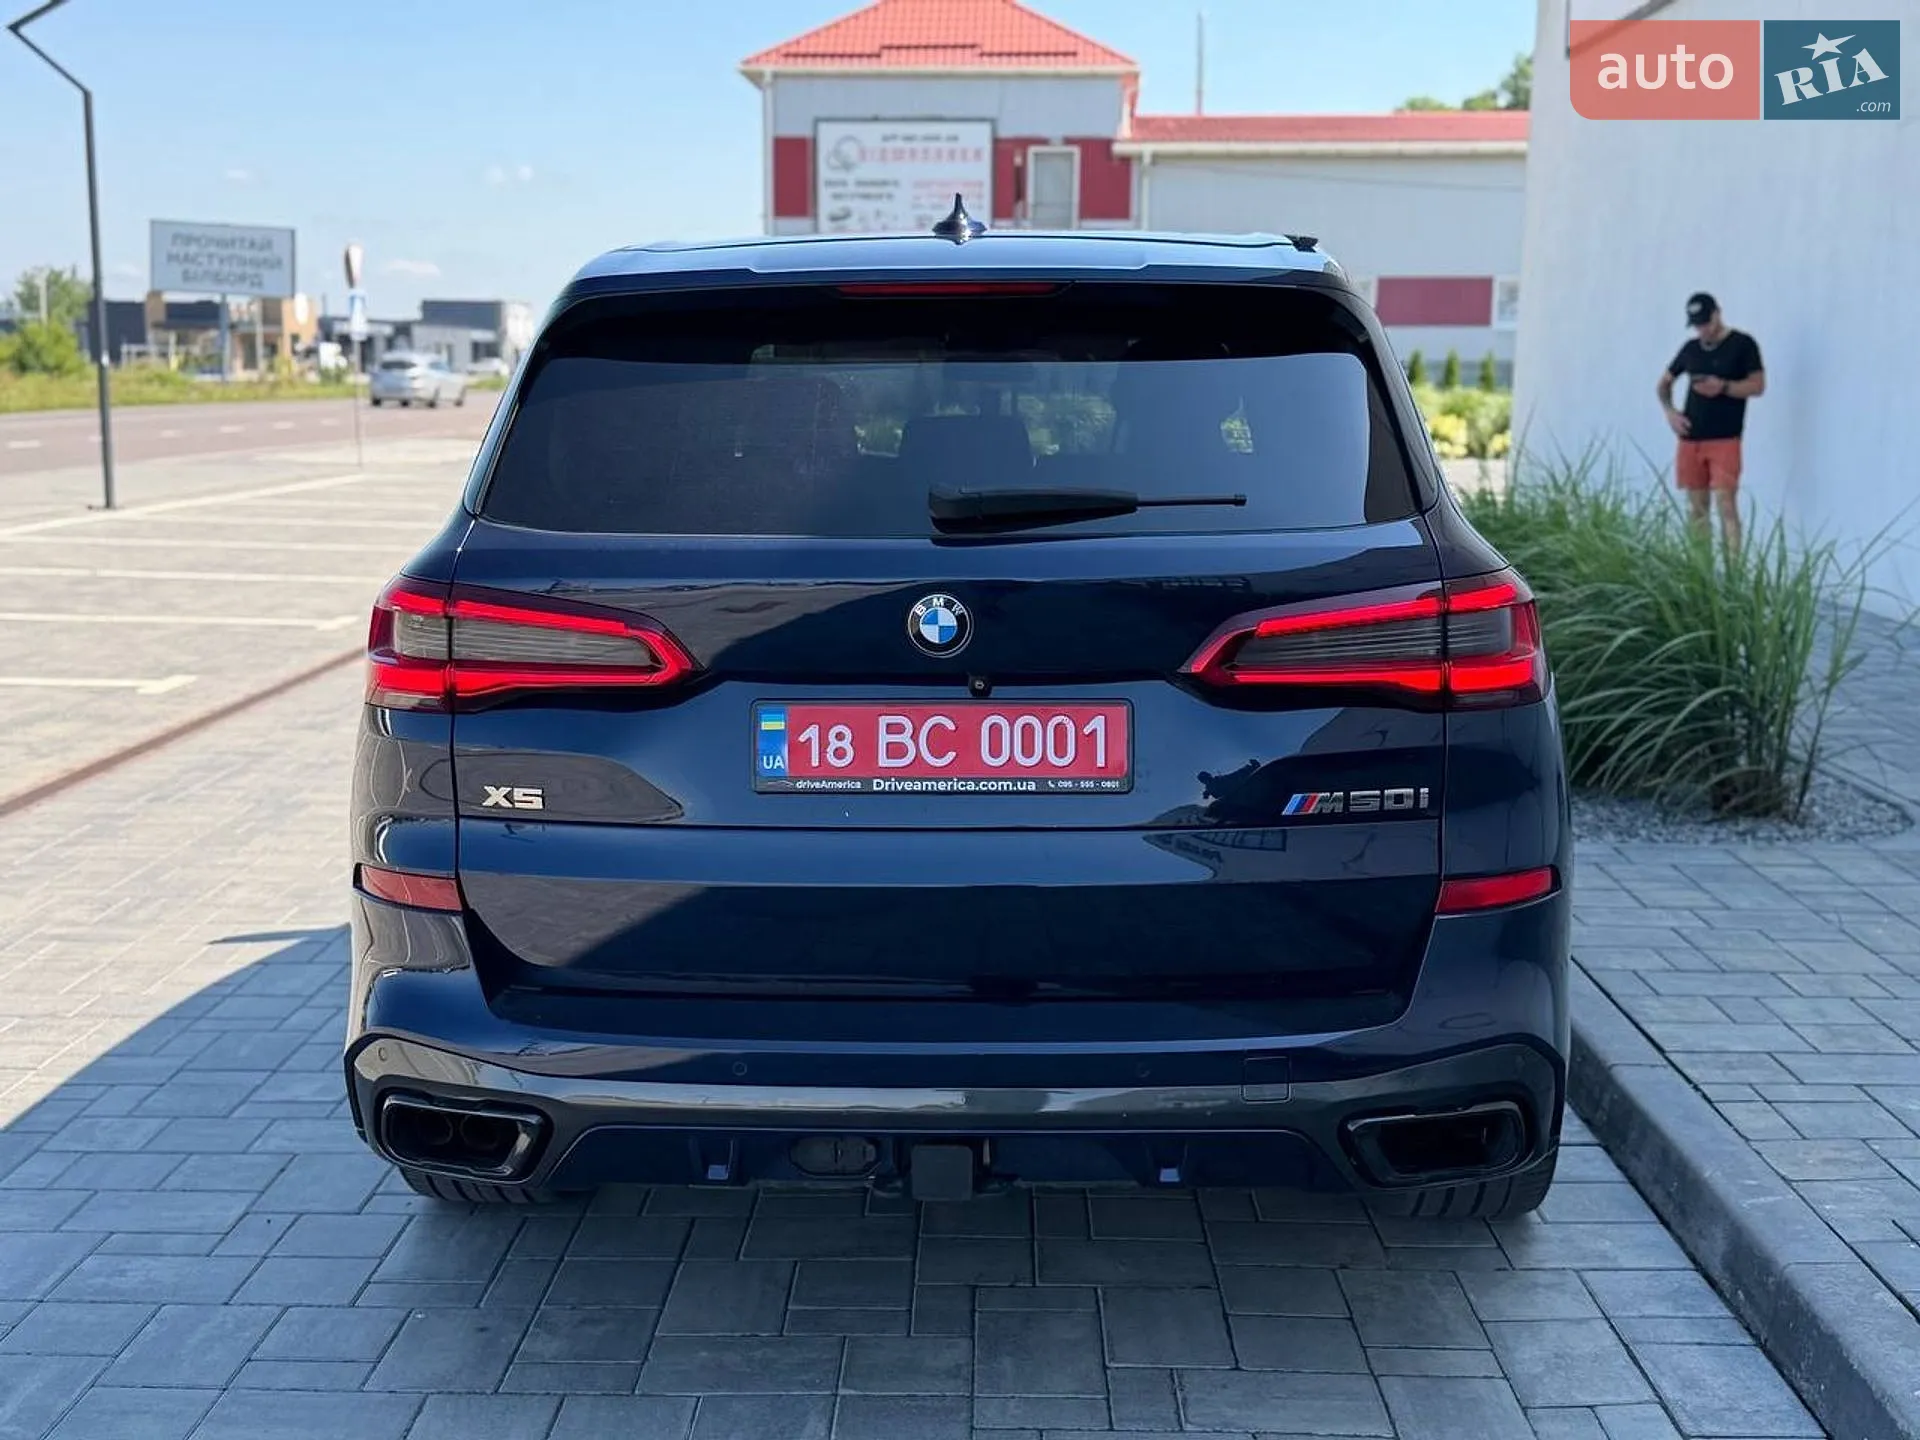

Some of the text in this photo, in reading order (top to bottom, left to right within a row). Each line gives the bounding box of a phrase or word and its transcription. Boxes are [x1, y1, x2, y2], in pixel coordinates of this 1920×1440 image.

[914, 597, 966, 617] BMW
[798, 715, 1106, 768] 18 BC 0001
[763, 756, 786, 770] UA
[872, 777, 1036, 791] Driveamerica.com.ua
[482, 785, 544, 810] X5
